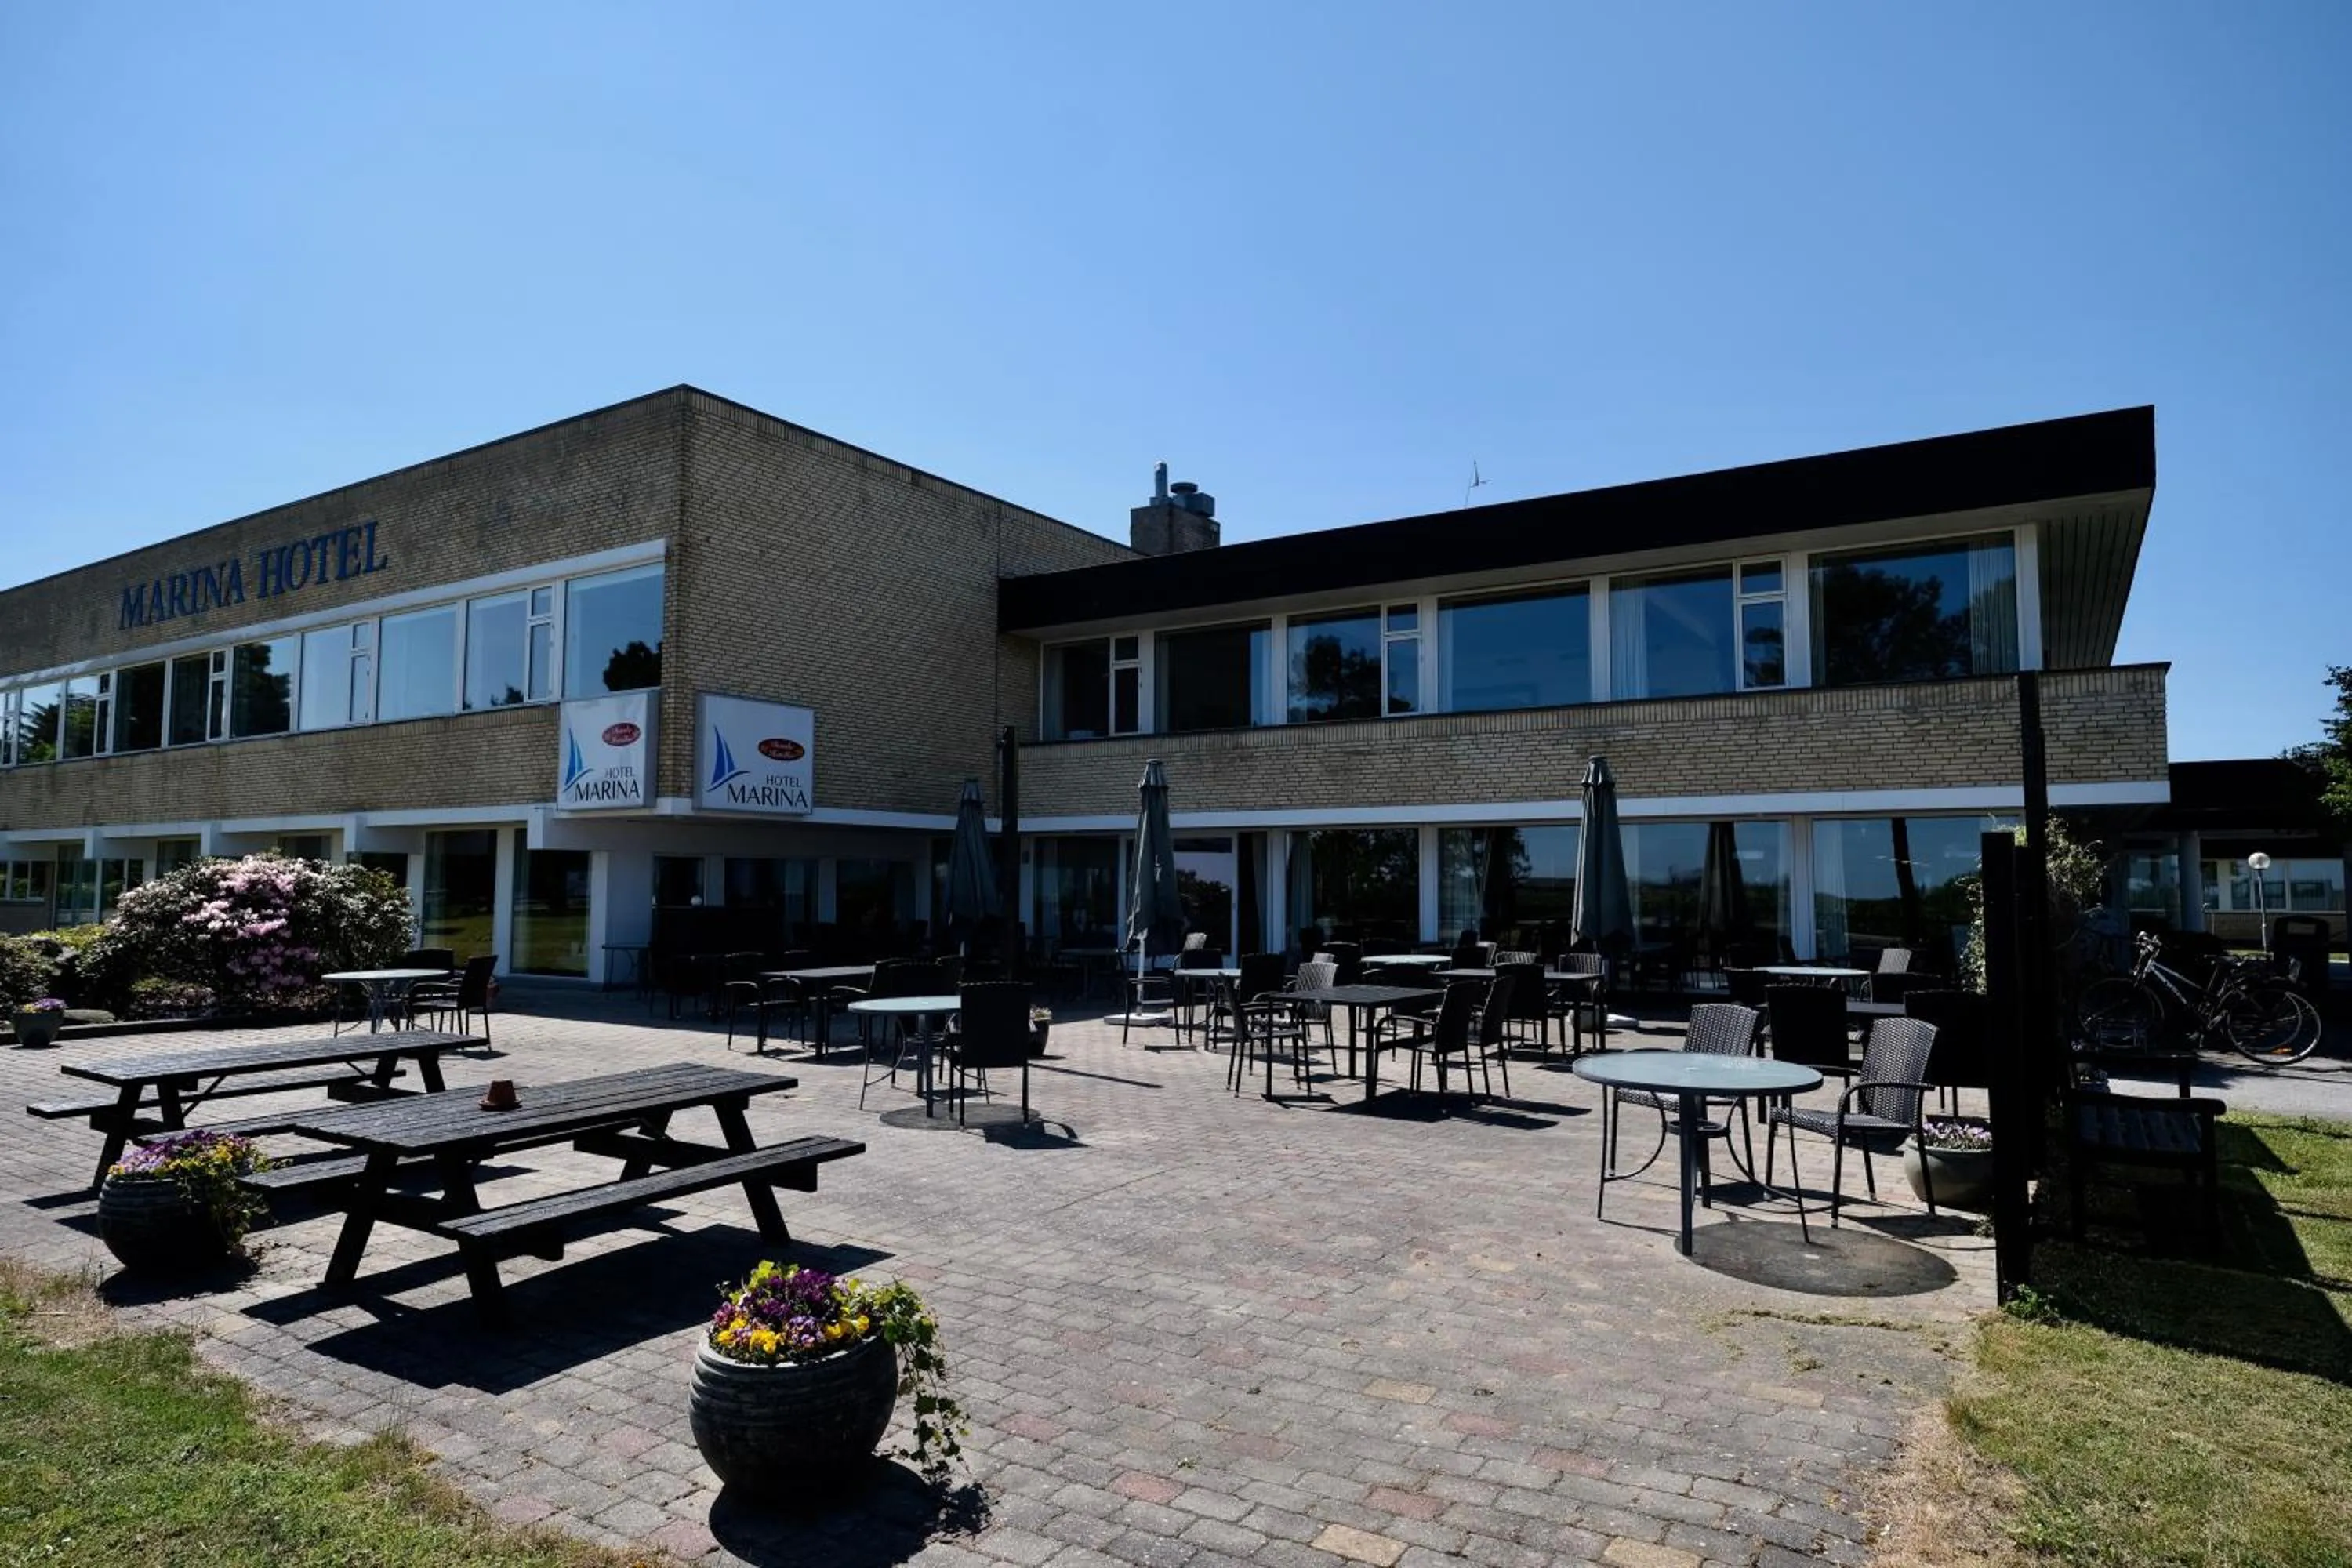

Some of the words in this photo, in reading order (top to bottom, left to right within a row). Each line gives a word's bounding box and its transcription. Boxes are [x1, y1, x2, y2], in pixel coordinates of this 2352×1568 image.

[120, 559, 245, 630] MARINA
[257, 521, 387, 598] HOTEL
[605, 767, 636, 779] HOTEL
[766, 774, 802, 788] HOTEL
[575, 779, 641, 801] MARINA
[728, 784, 808, 808] MARINA
